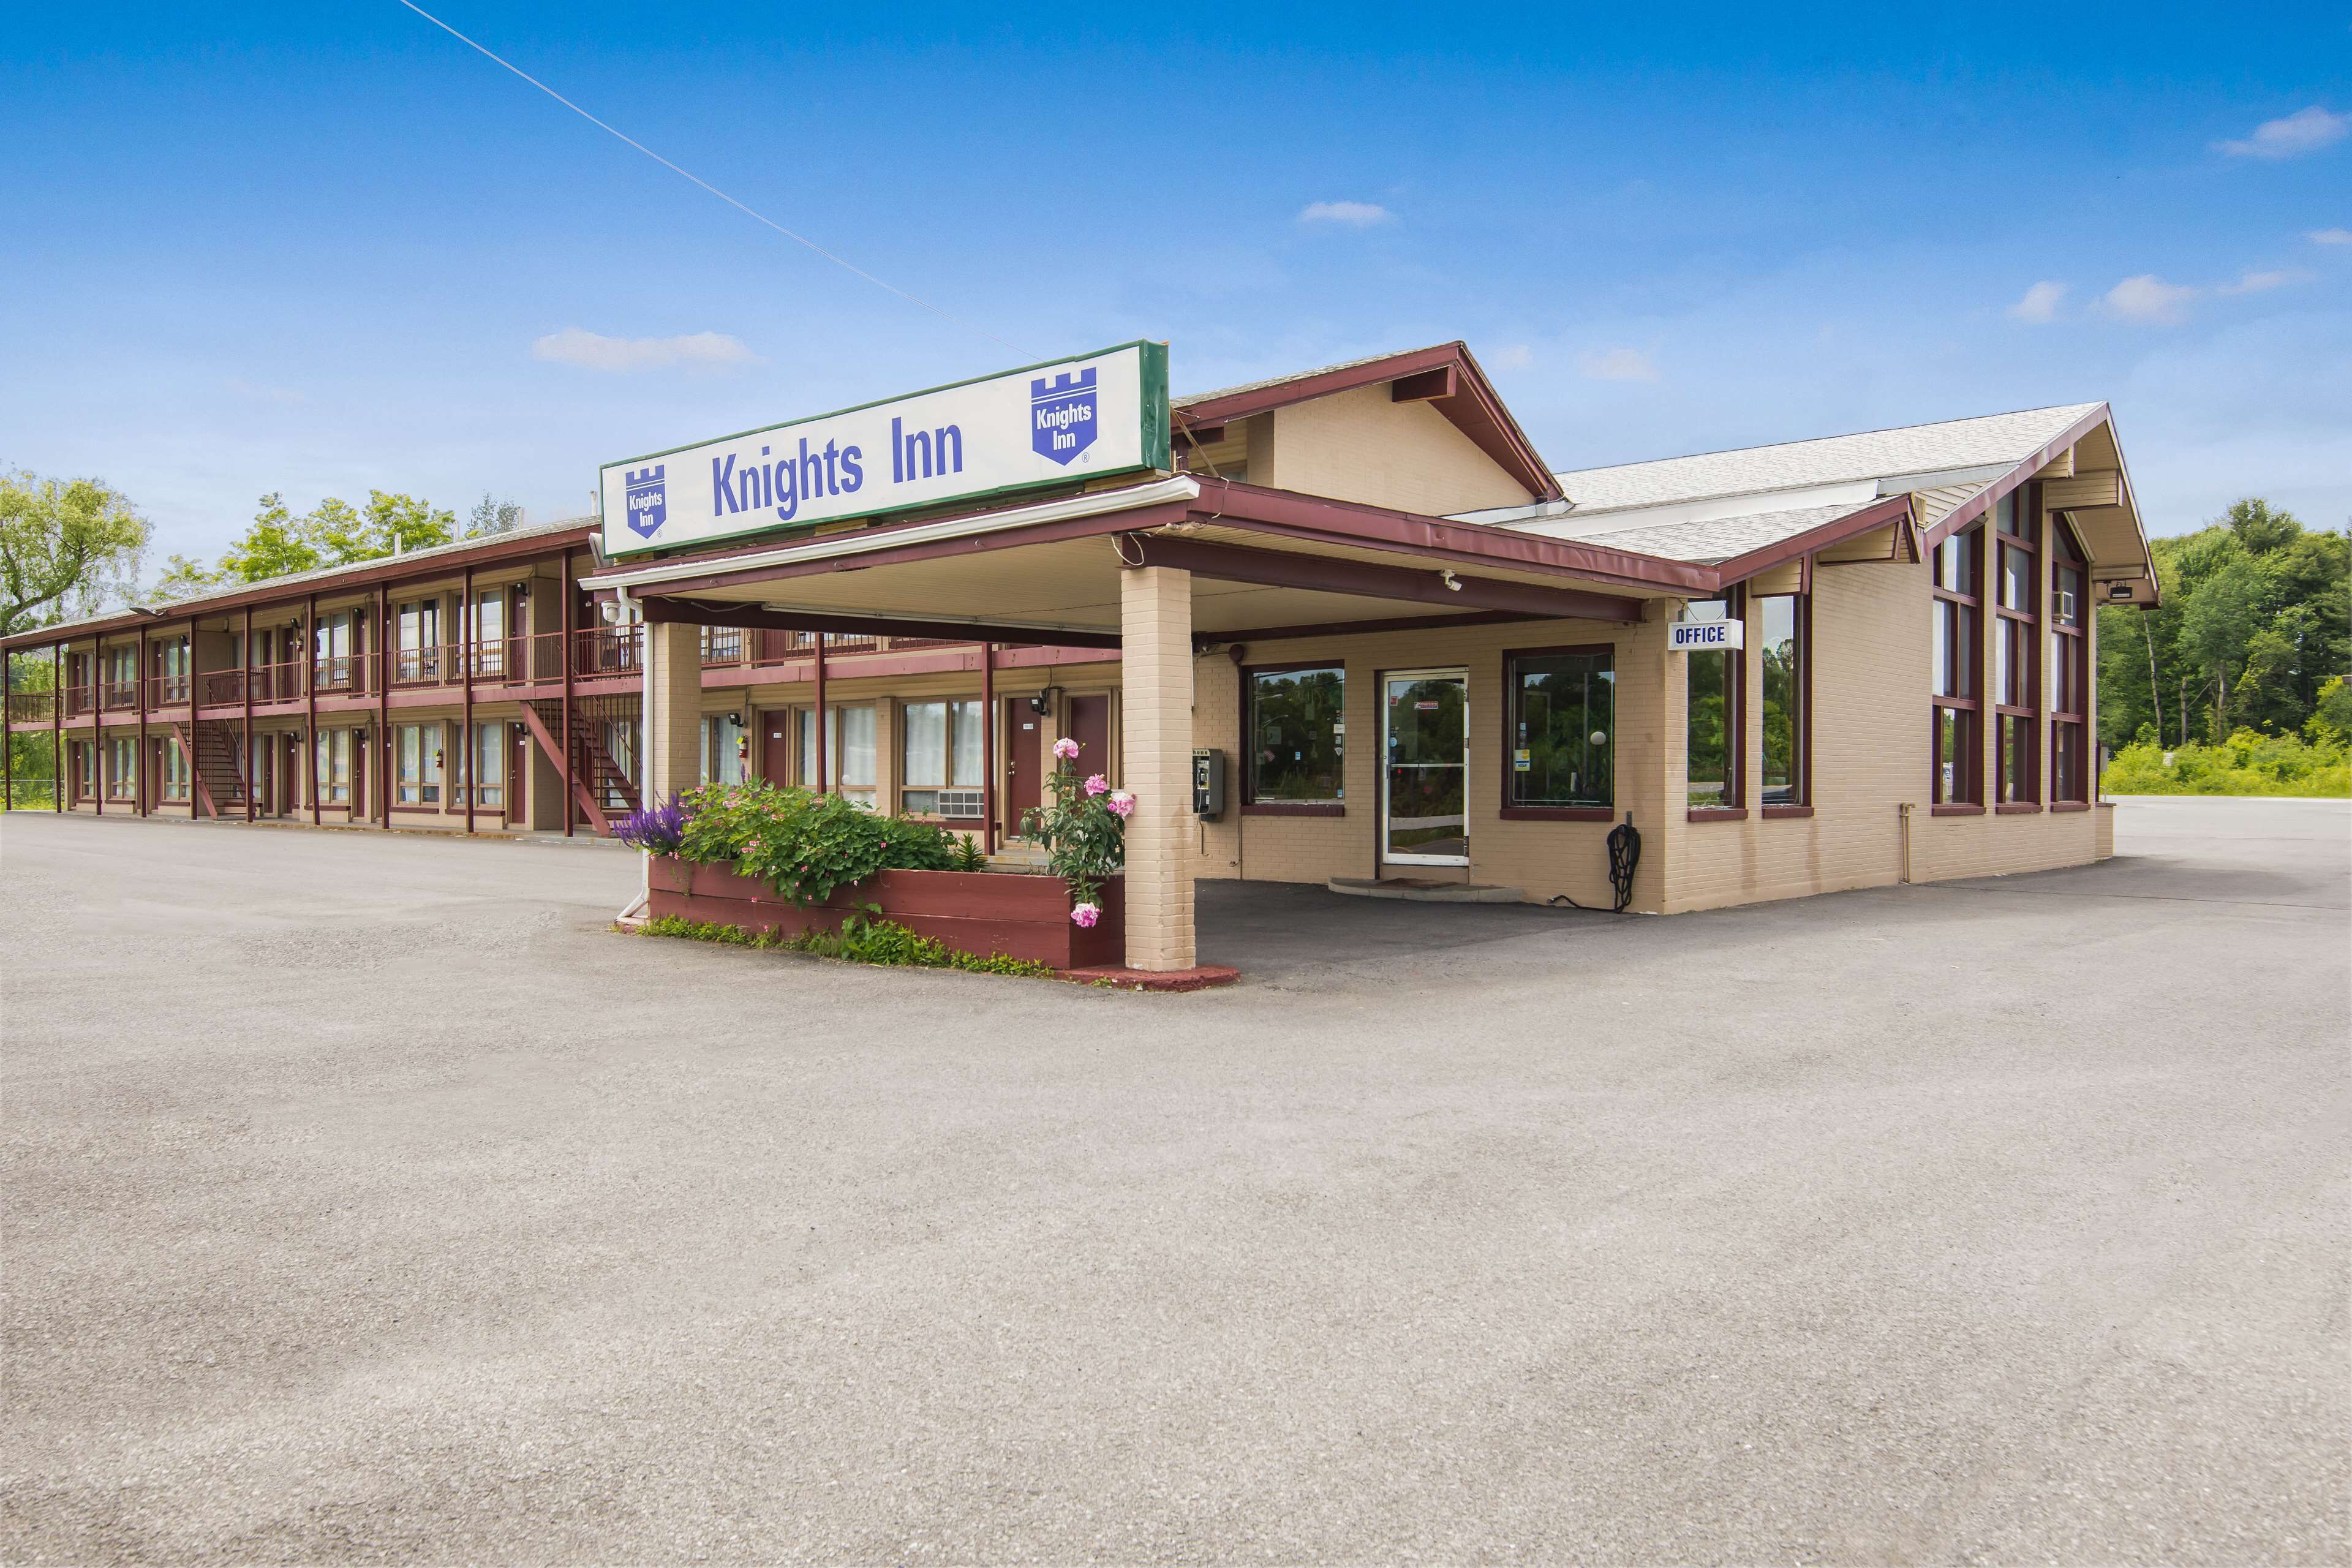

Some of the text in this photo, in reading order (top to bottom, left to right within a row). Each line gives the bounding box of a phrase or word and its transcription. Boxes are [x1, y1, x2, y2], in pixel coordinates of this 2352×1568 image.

[1036, 403, 1092, 430] Knights
[1053, 430, 1076, 450] Inn
[712, 417, 963, 521] Knights Inn
[629, 491, 663, 511] Knights
[639, 511, 654, 527] Inn
[1675, 626, 1725, 644] OFFICE
